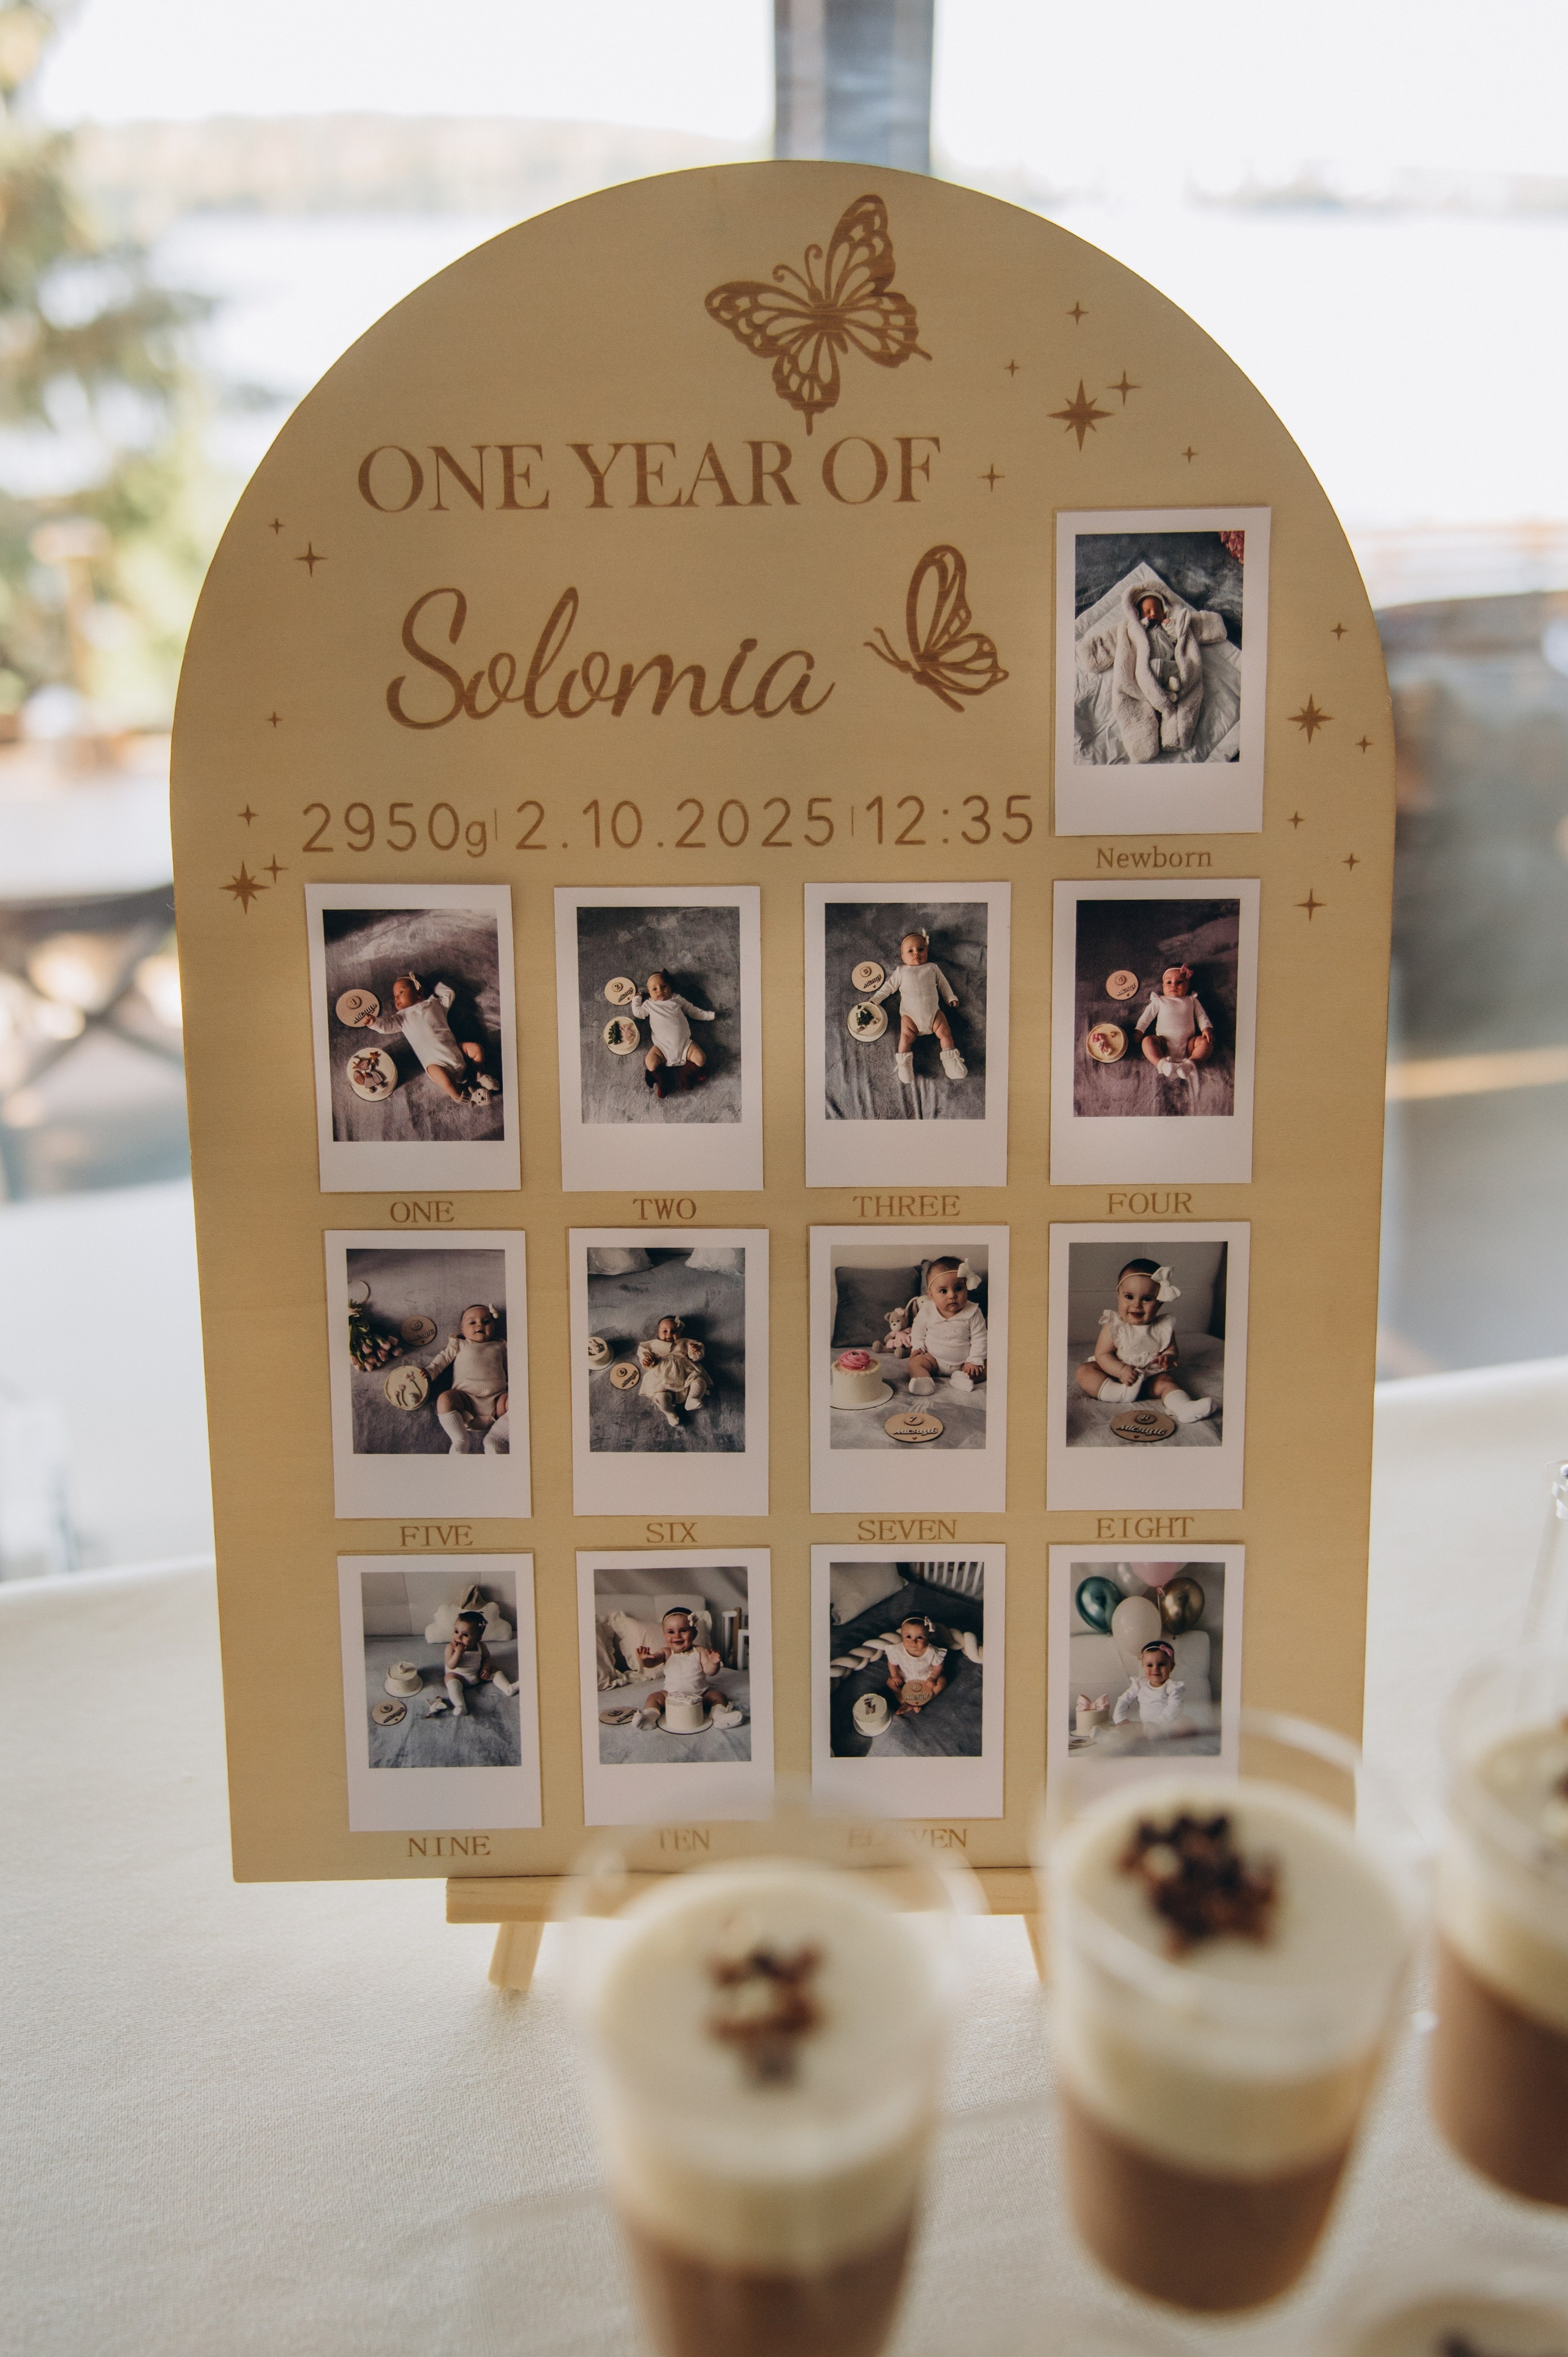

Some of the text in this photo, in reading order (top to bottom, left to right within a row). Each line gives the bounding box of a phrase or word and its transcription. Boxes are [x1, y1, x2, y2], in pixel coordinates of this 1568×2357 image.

[358, 436, 941, 513] ONE YEAR OF
[385, 586, 835, 731] Solomia
[302, 802, 488, 858] 2950g
[865, 794, 1033, 845] 12:35
[1096, 845, 1212, 869] Newborn
[390, 1201, 454, 1223] ONE
[633, 1198, 697, 1221] TWO
[853, 1195, 960, 1218] THREE
[1106, 1192, 1193, 1215] FOUR
[399, 1525, 473, 1547] FIVE
[646, 1522, 698, 1544] SIX
[858, 1519, 957, 1541] SEVEN
[1096, 1517, 1195, 1539] EIGHT
[407, 1836, 491, 1858] NINE
